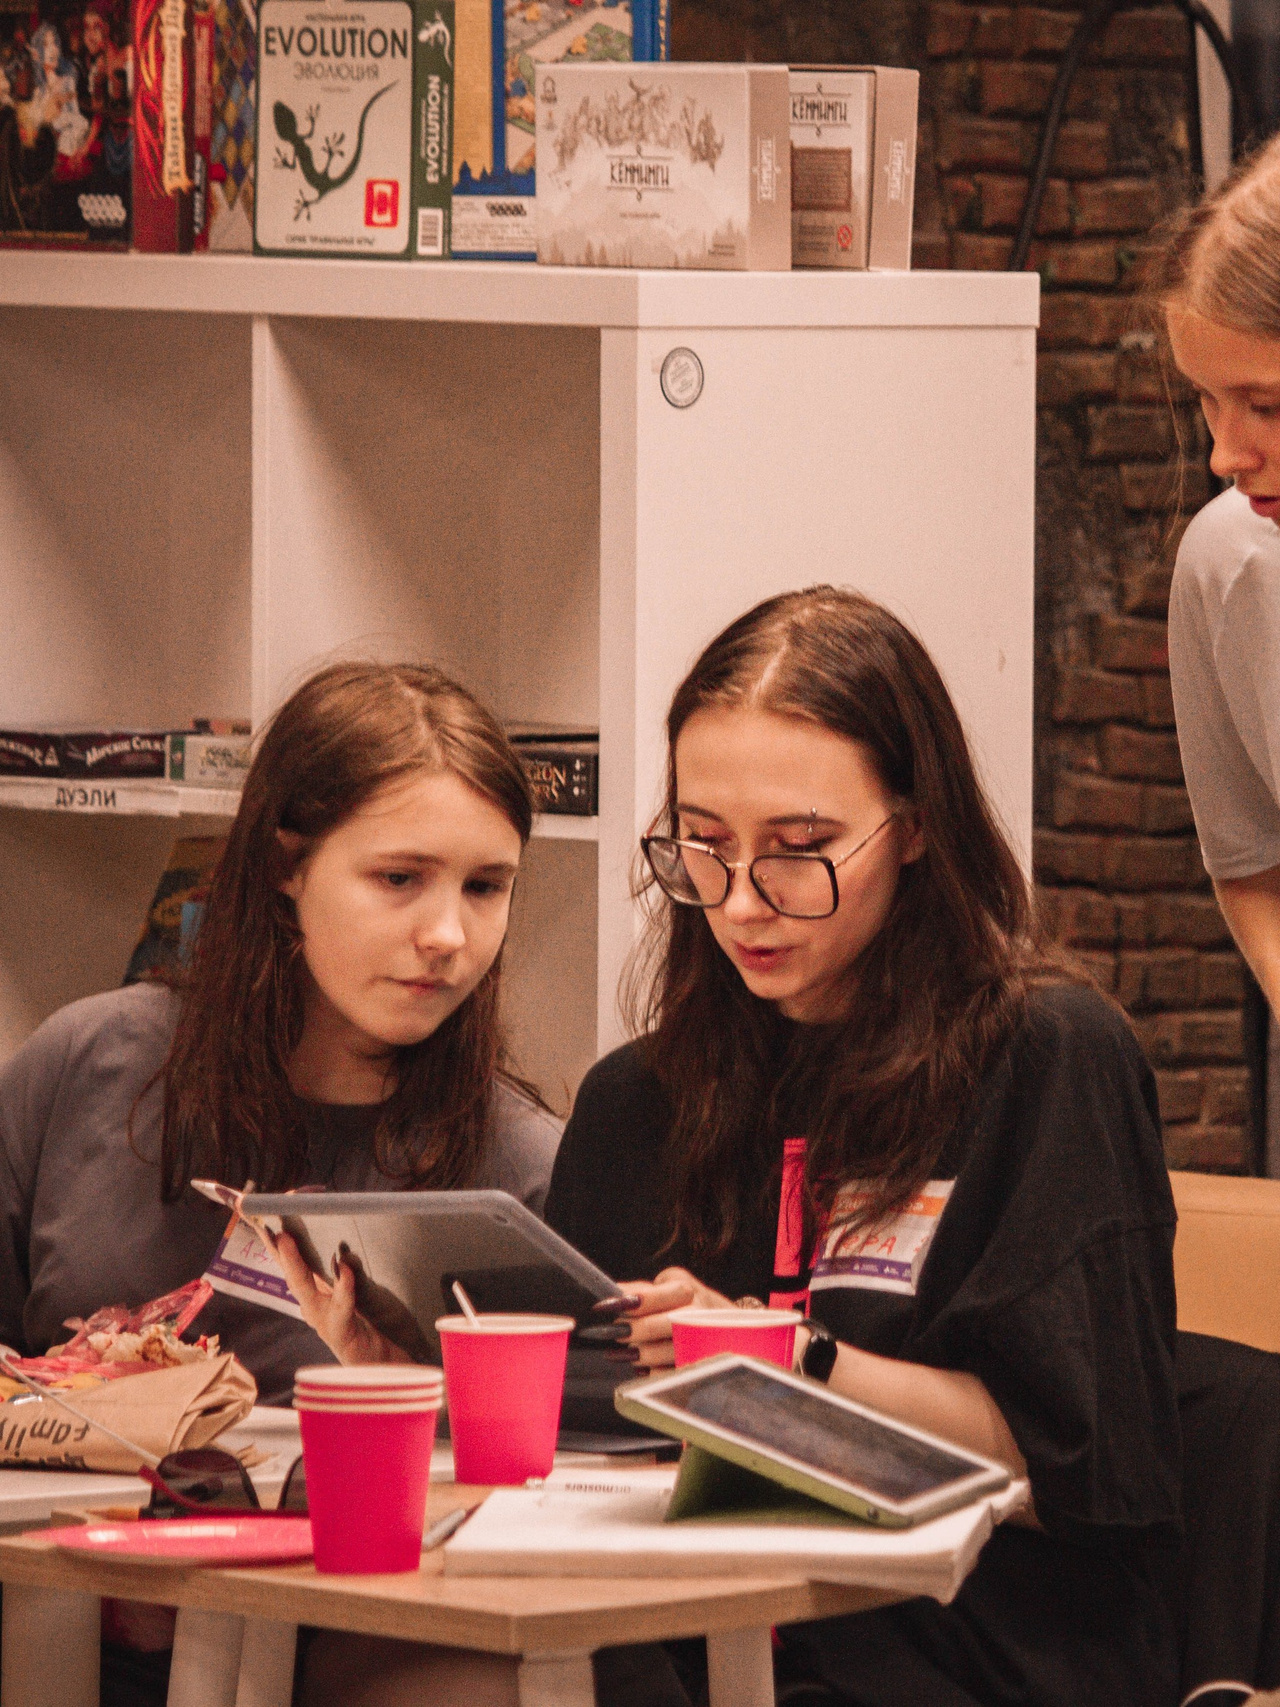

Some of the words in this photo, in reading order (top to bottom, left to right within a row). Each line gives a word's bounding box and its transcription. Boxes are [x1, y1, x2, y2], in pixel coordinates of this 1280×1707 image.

[264, 26, 408, 59] EVOLUTION
[293, 62, 380, 81] ЭВОЛЮЦИЯ
[426, 74, 441, 184] EVOLUTION
[56, 787, 117, 807] ДУЭЛИ
